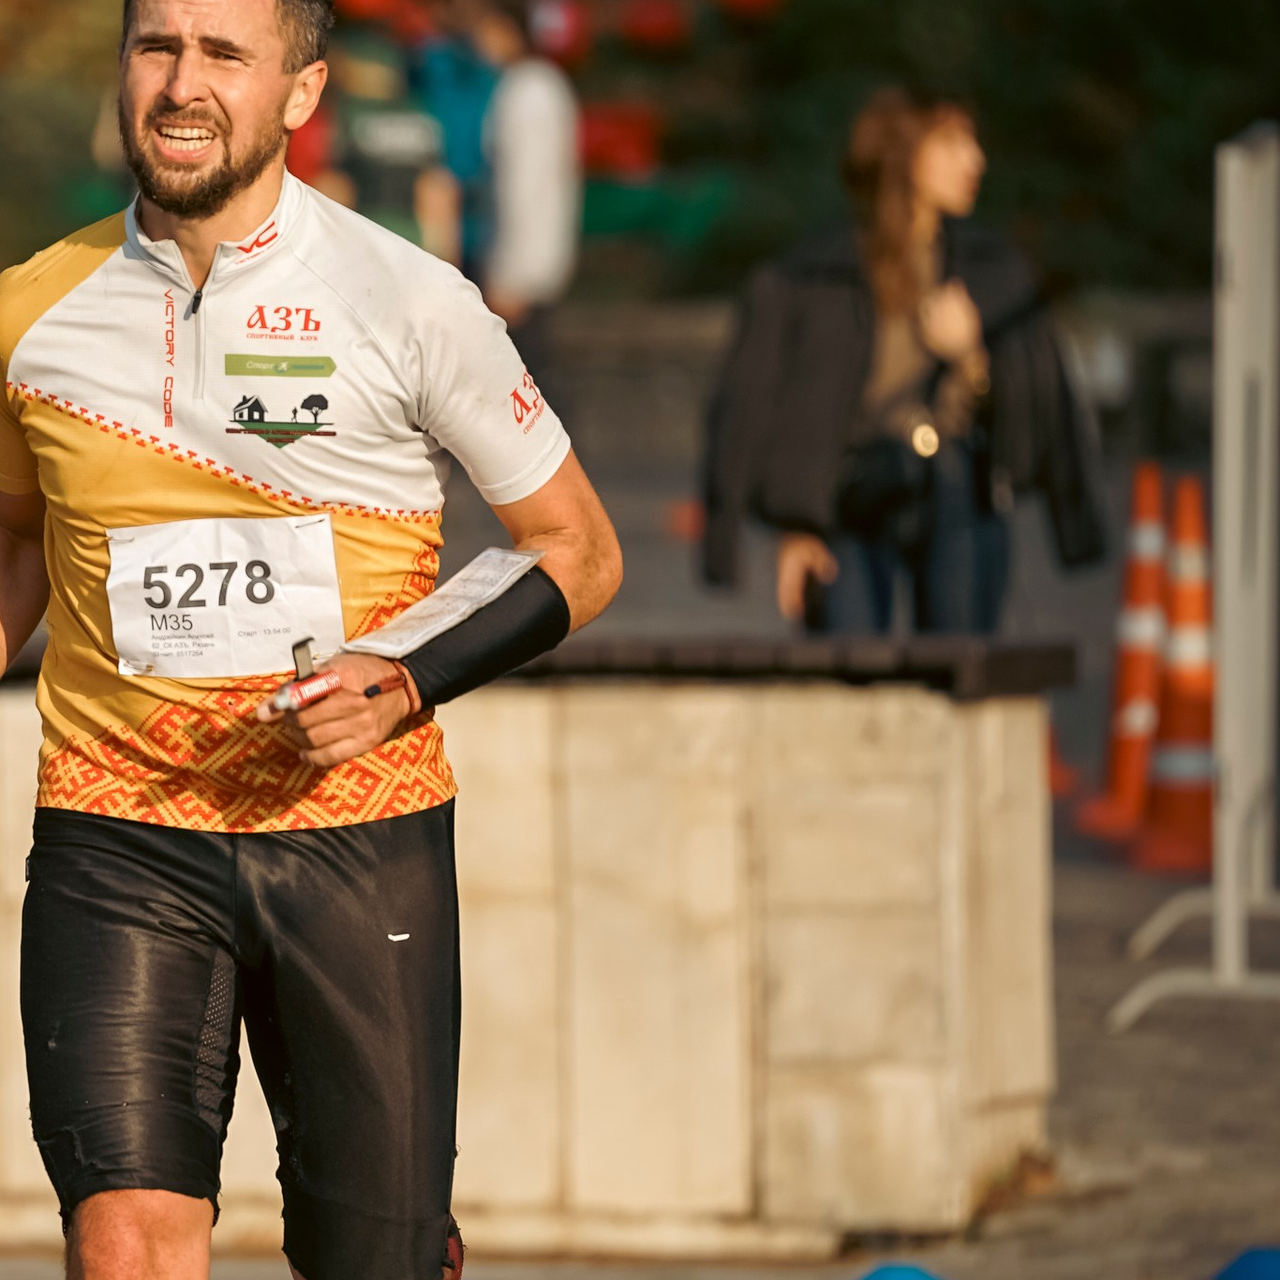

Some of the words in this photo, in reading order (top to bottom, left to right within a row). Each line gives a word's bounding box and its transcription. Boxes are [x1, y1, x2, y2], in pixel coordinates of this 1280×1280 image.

[164, 288, 175, 367] VICTORY
[246, 304, 322, 333] АЗЪ
[163, 376, 174, 428] CODE
[509, 372, 540, 424] АЗ
[143, 559, 275, 609] 5278
